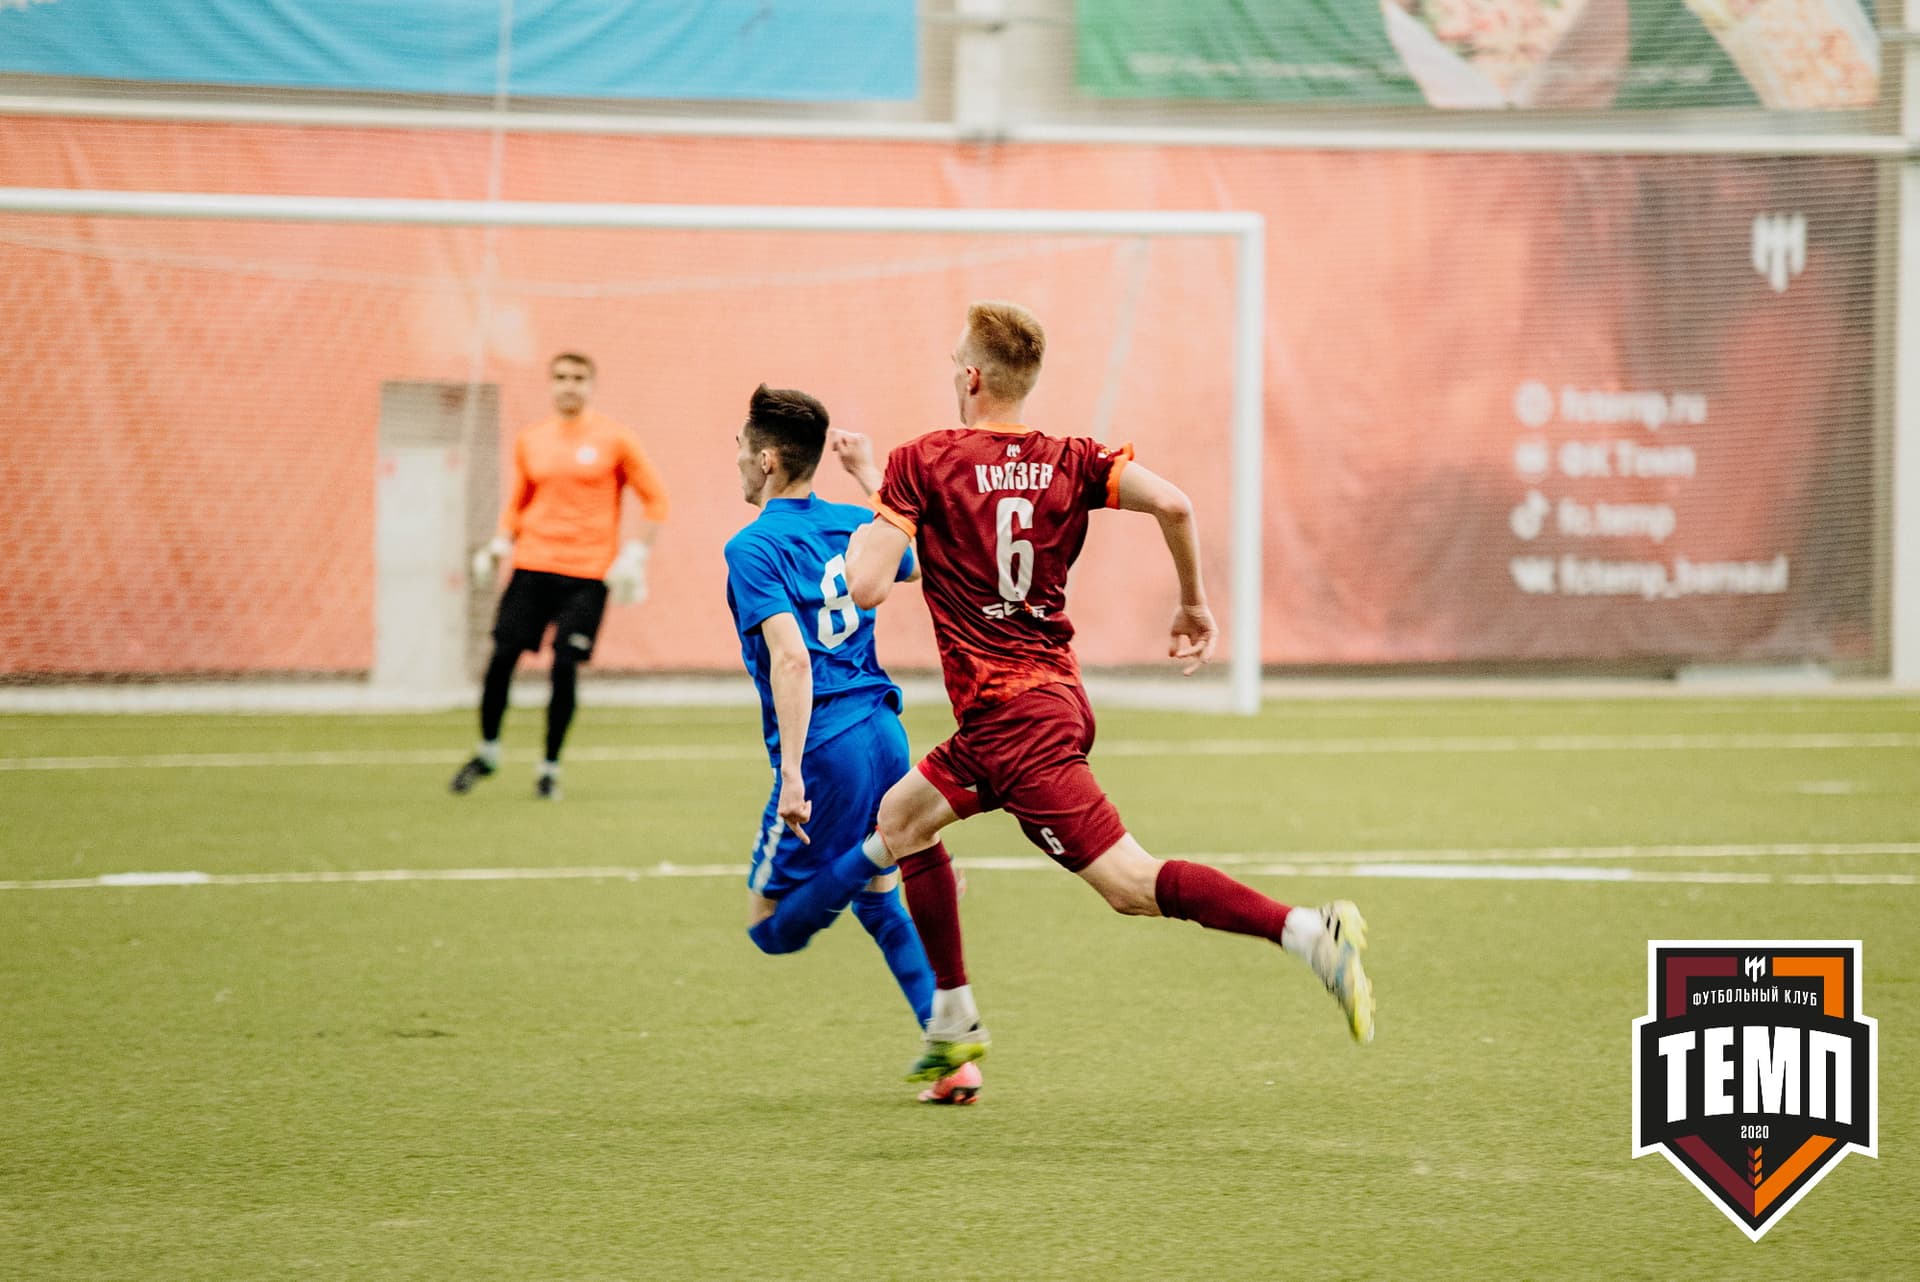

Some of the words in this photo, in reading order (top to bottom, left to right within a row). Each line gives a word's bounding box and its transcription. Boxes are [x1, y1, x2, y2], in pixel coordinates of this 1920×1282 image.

[974, 461, 1054, 494] КНЯЗЕВ
[995, 496, 1035, 602] 6
[817, 553, 860, 650] 8
[1040, 826, 1066, 855] 6
